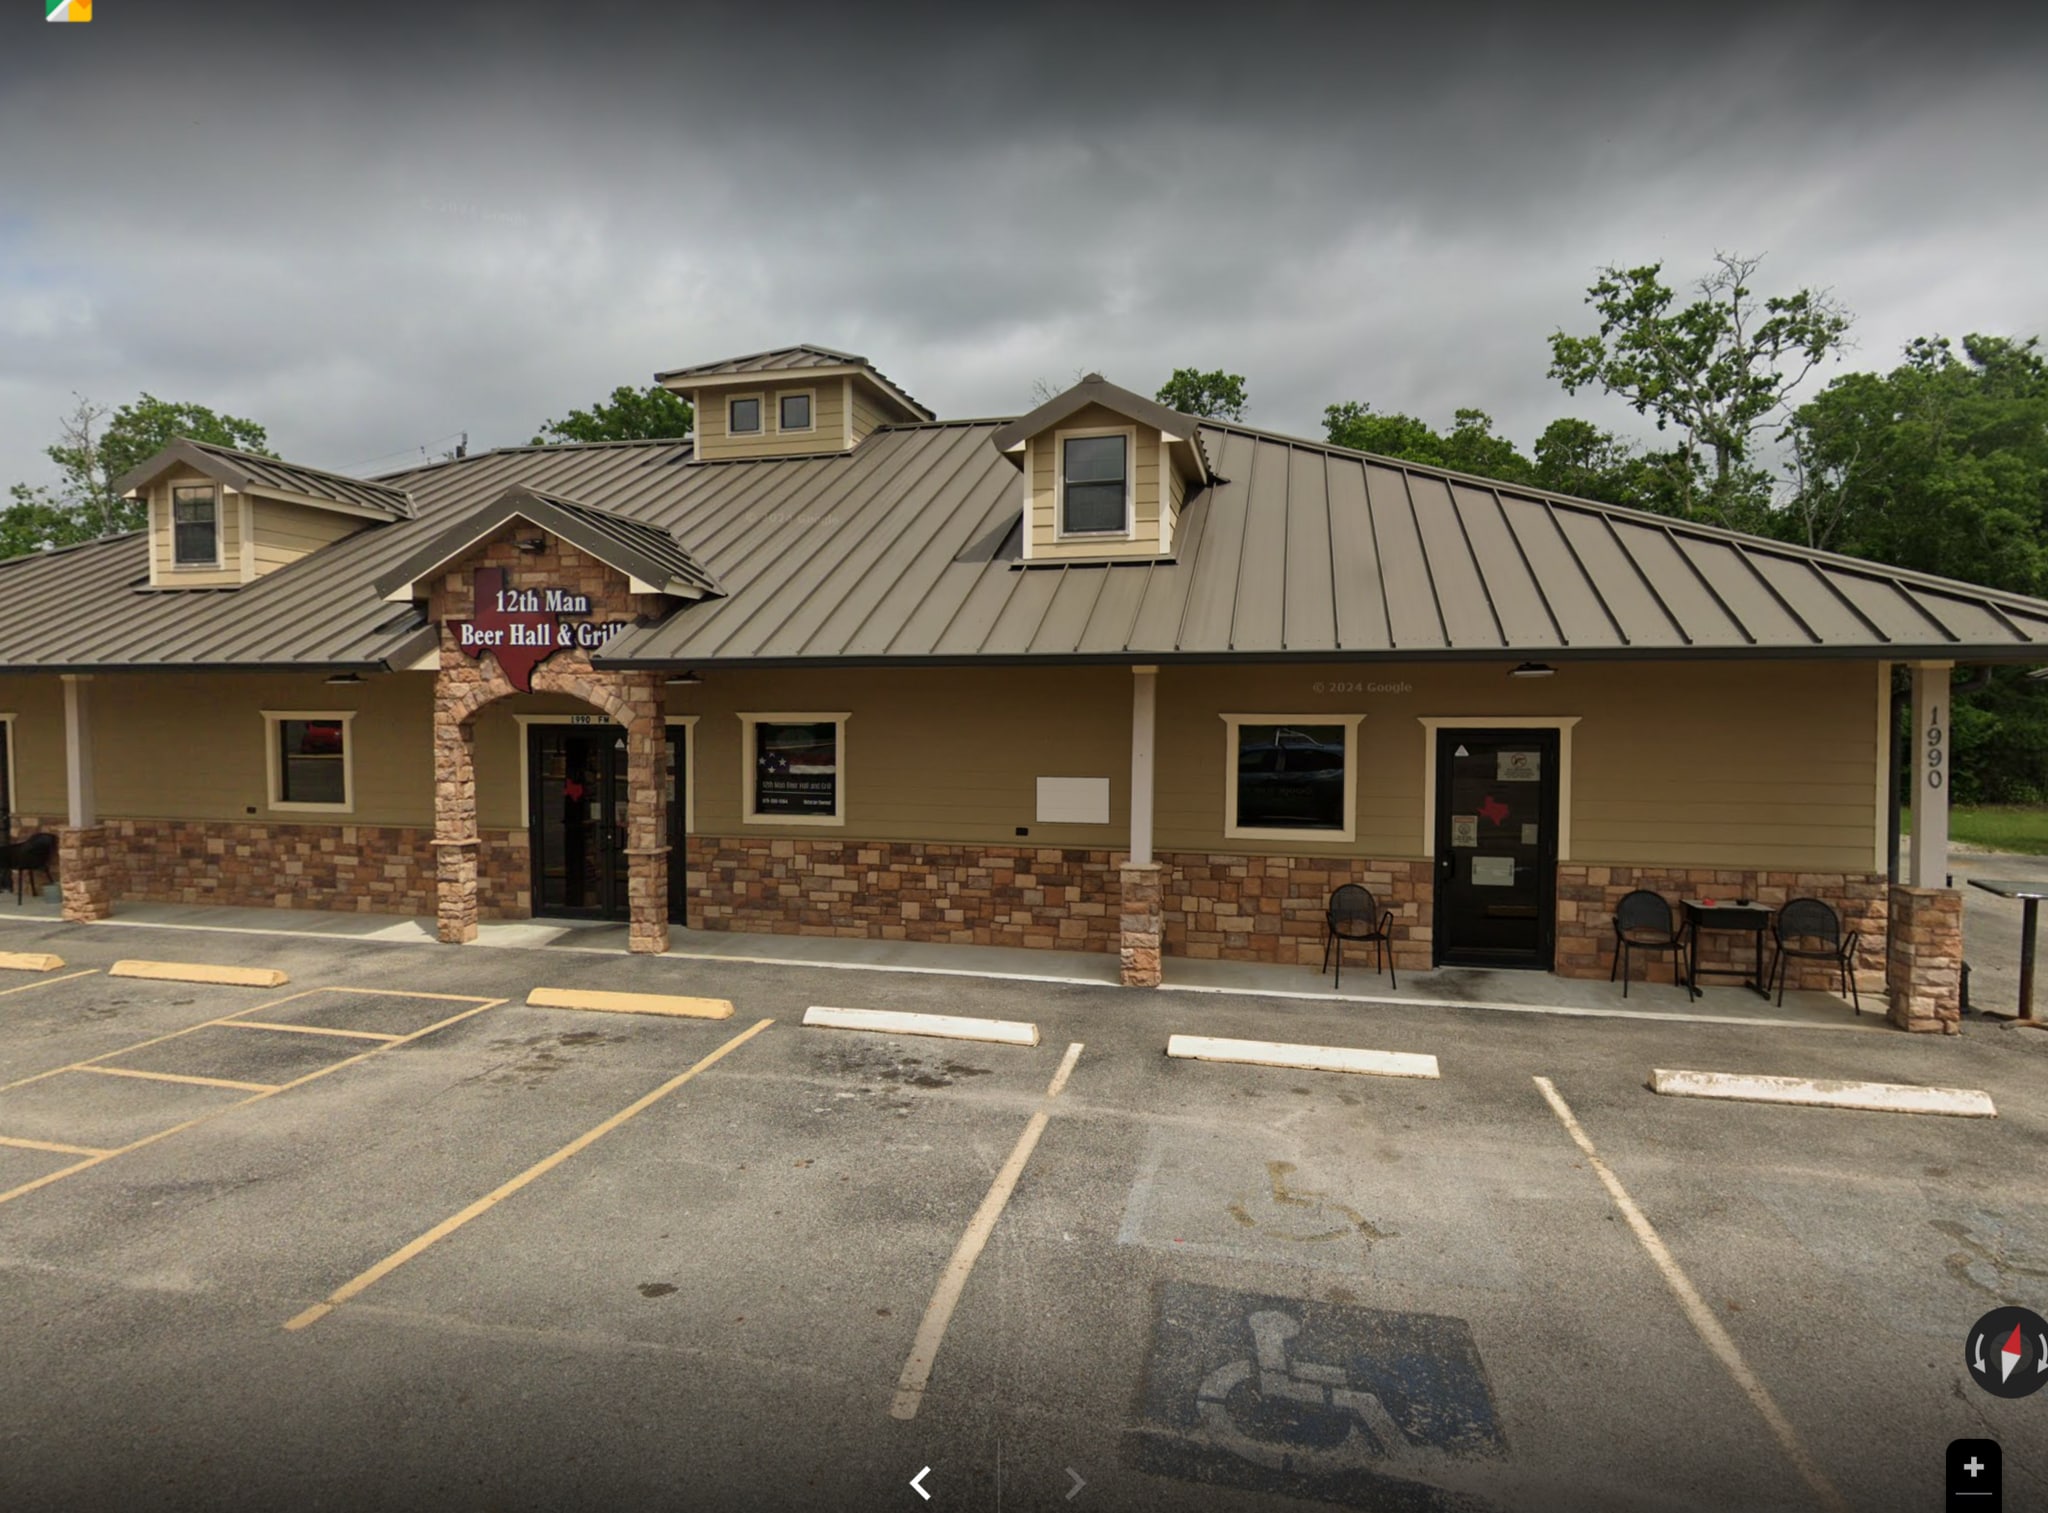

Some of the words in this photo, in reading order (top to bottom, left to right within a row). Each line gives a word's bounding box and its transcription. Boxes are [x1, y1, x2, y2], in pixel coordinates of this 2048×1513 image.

[496, 590, 539, 612] 12th
[545, 590, 587, 612] Man
[461, 623, 504, 646] Beer
[509, 623, 551, 646] Hall
[556, 624, 572, 646] &
[571, 715, 590, 725] 1990
[1926, 705, 1942, 789] 1990
